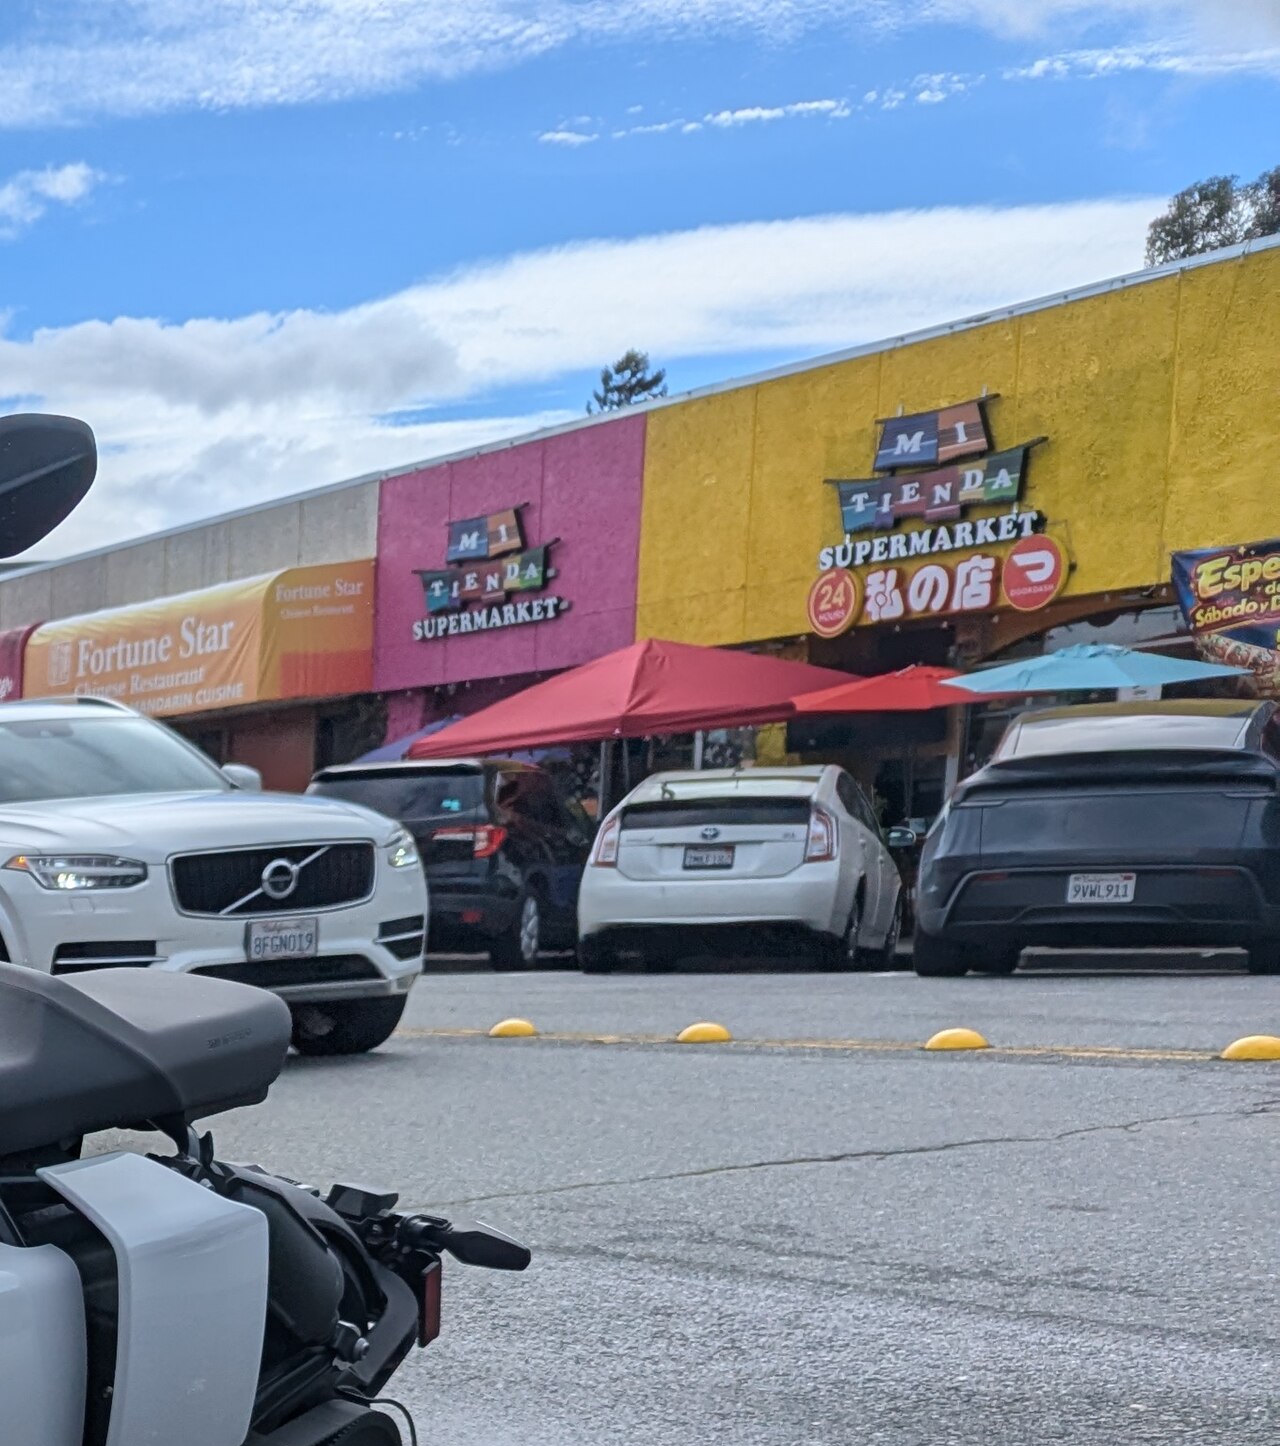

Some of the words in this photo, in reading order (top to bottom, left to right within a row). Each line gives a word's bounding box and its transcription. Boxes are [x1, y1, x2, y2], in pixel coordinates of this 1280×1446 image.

[893, 421, 967, 456] MI
[851, 468, 1013, 514] TIENDA
[458, 524, 508, 552] MI
[817, 511, 1038, 571] SUPERMARKET
[276, 584, 330, 601] Fortune
[335, 579, 364, 596] Star
[430, 562, 539, 598] TIENDA
[820, 581, 845, 611] 24
[864, 554, 996, 622] 私の店
[412, 597, 558, 641] SUPERMARKET
[1195, 598, 1258, 628] Sábado
[1260, 600, 1269, 614] y
[77, 638, 172, 677] Fortune
[179, 616, 234, 659] Star
[130, 667, 204, 694] Restaurant
[195, 683, 244, 704] CUISINE
[1073, 884, 1129, 899] 9VWL911
